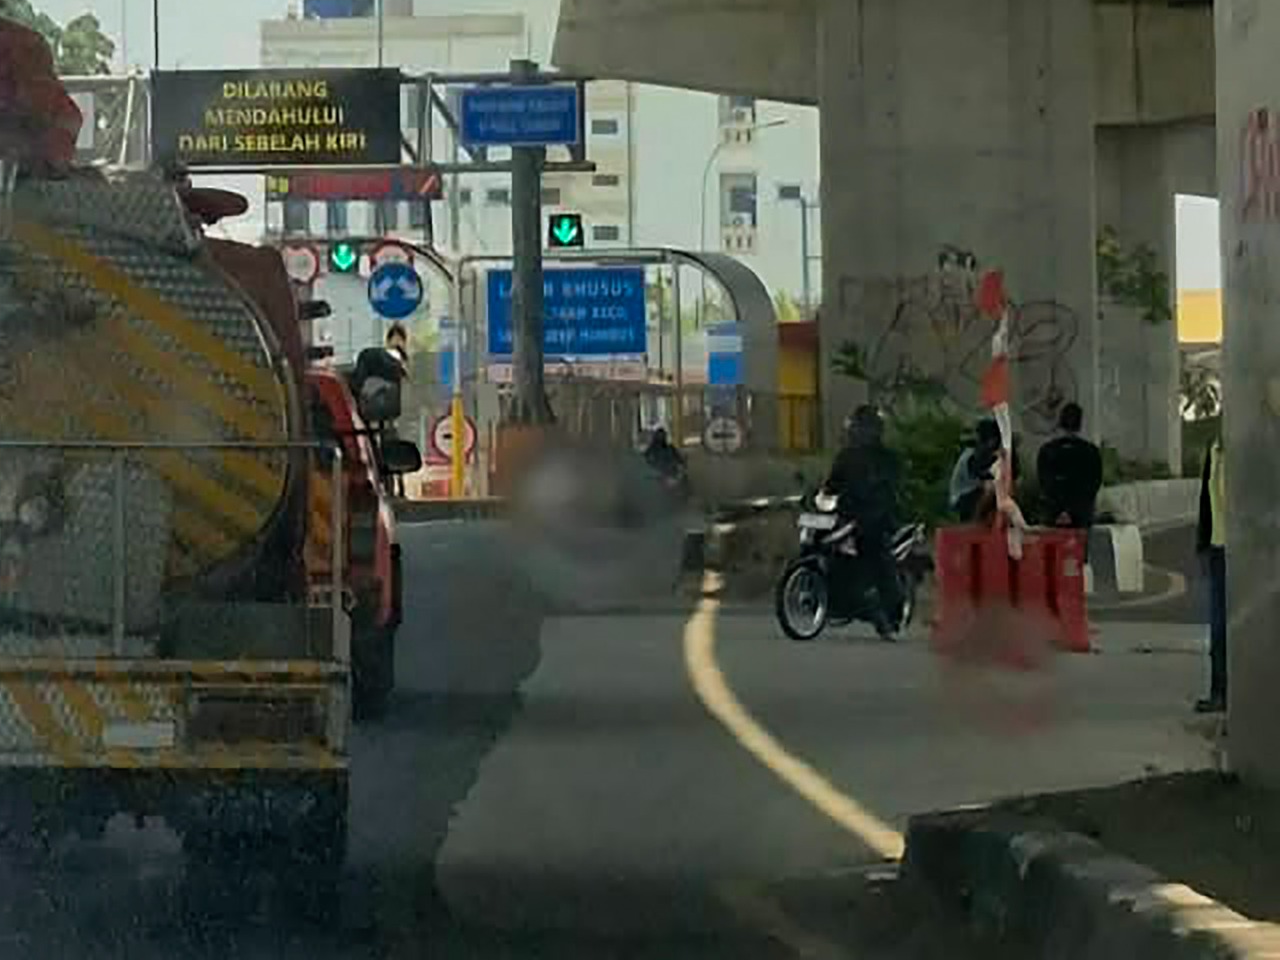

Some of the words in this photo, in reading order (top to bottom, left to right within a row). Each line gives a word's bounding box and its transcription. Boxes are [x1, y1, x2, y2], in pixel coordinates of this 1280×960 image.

[223, 81, 327, 98] DILARANG
[205, 106, 344, 125] MENDAHULUI
[178, 134, 228, 152] DARI
[234, 133, 319, 152] SEBELAH
[325, 131, 367, 151] KIRI
